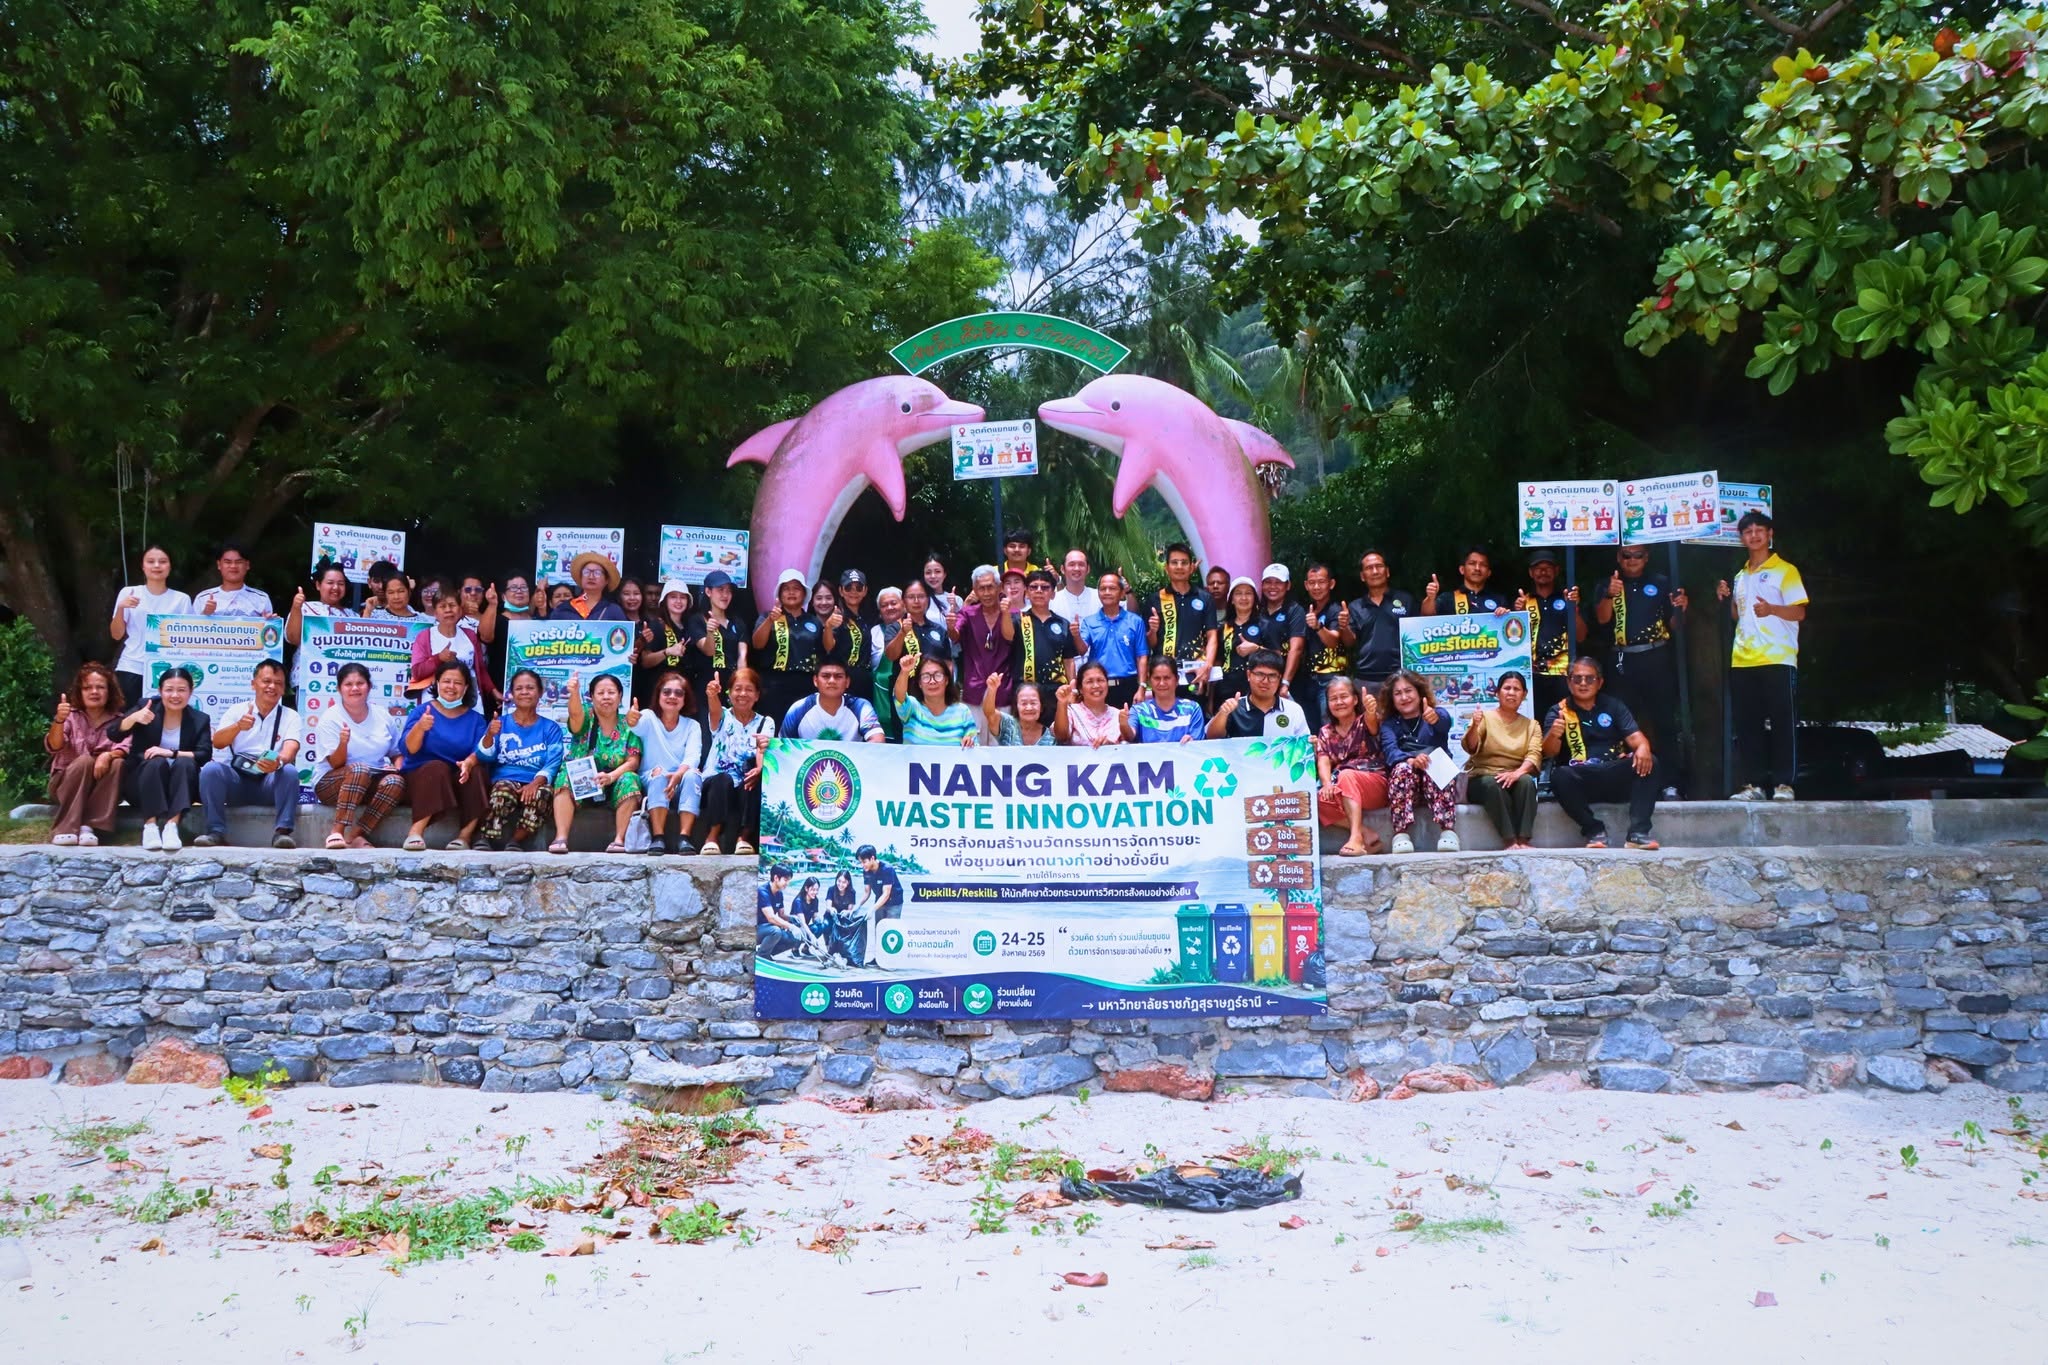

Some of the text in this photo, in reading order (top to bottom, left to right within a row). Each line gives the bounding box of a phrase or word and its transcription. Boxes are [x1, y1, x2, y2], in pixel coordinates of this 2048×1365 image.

[166, 622, 259, 635] กติกาการคัดแยกขยะ
[529, 623, 586, 644] จุดรับซื้อ
[1423, 618, 1481, 642] จุดรับซื้อ
[169, 634, 256, 647] ชุมชนหาดนางกำ
[1419, 634, 1498, 655] ขยะรีไซเคิล
[525, 639, 601, 657] ขยะรีไซเคิล
[908, 760, 1175, 798] NANG KAM
[1274, 797, 1300, 805] ลดขยะ
[876, 799, 994, 829] WASTE
[1006, 799, 1214, 830] INNOVATION
[910, 834, 1201, 849] วิศวกรสังคมสร้างนวัตกรรมการจัดการขยะ
[944, 849, 1170, 871] เพื่อชุมชนหาดนางกำอย่างยั่งยืน
[1026, 871, 1081, 880] ภายใต้โครงการ
[1278, 876, 1304, 884] Recycle
[918, 887, 998, 900] Upskills/Reskills
[1001, 931, 1046, 946] 24-25
[1028, 949, 1046, 957] 2569
[834, 988, 863, 998] ร่วมคิด
[918, 989, 944, 999] ร่วมทำ
[997, 985, 1036, 997] ร่วมเปลี่ยน
[1098, 995, 1262, 1013] มหาวิทยาลัยราชภัฏสุราษฎร์ธานี
